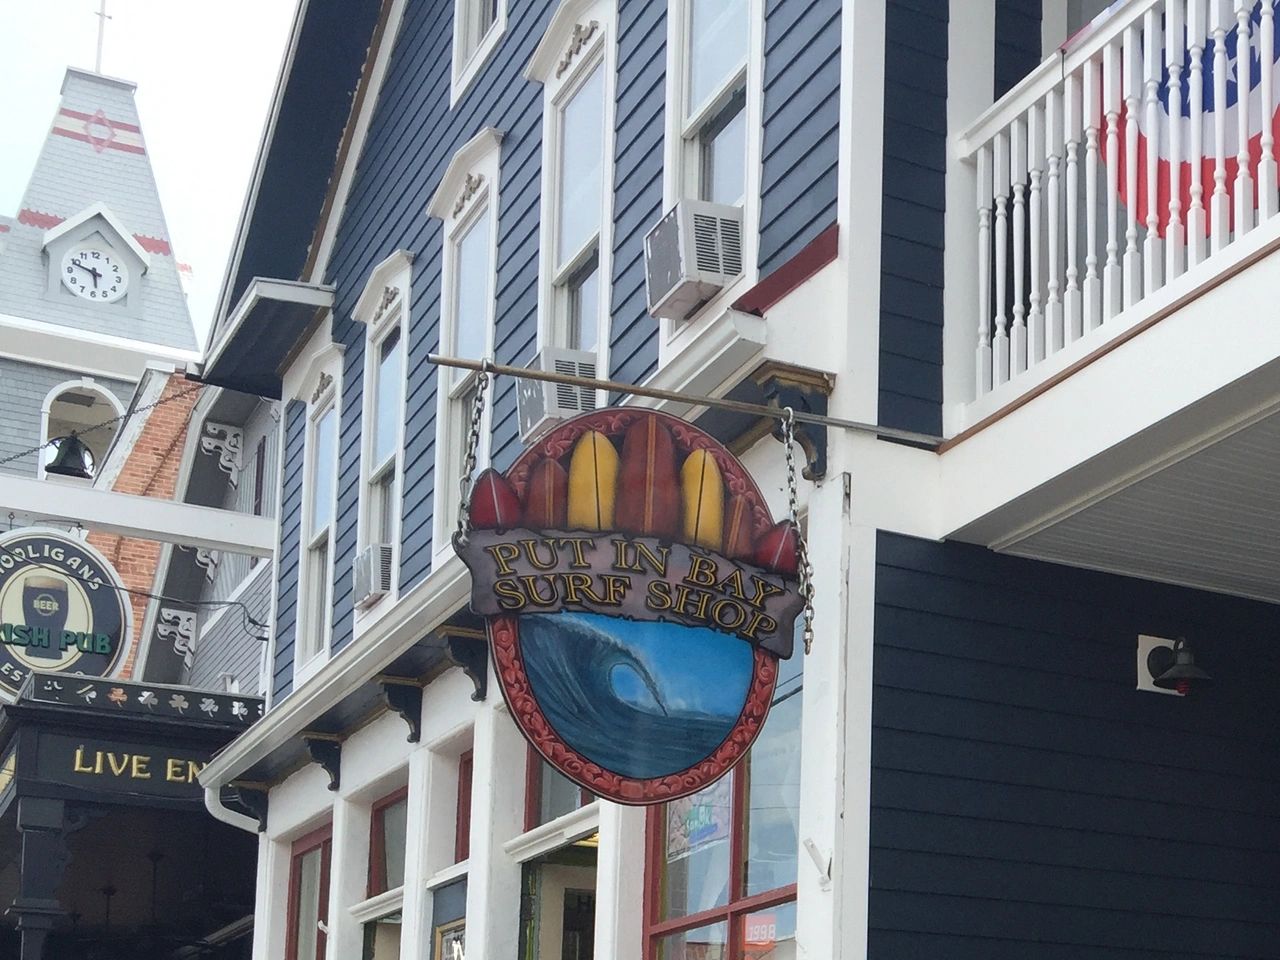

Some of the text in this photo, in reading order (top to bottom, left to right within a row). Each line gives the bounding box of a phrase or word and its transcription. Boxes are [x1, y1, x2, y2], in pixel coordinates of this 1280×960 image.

[80, 252, 87, 260] 11
[91, 251, 100, 260] 12
[71, 258, 81, 266] 10
[112, 264, 119, 272] 2
[115, 276, 122, 284] 3
[90, 290, 96, 298] 6
[102, 290, 108, 298] 5
[0, 545, 103, 591] OOLIGANS
[487, 537, 786, 609] PUT IN BAY
[33, 600, 59, 611] BEER
[493, 573, 779, 638] SURF SHOP
[0, 623, 112, 655] ISH PUB
[1, 662, 30, 682] ES
[74, 749, 151, 778] LIVE
